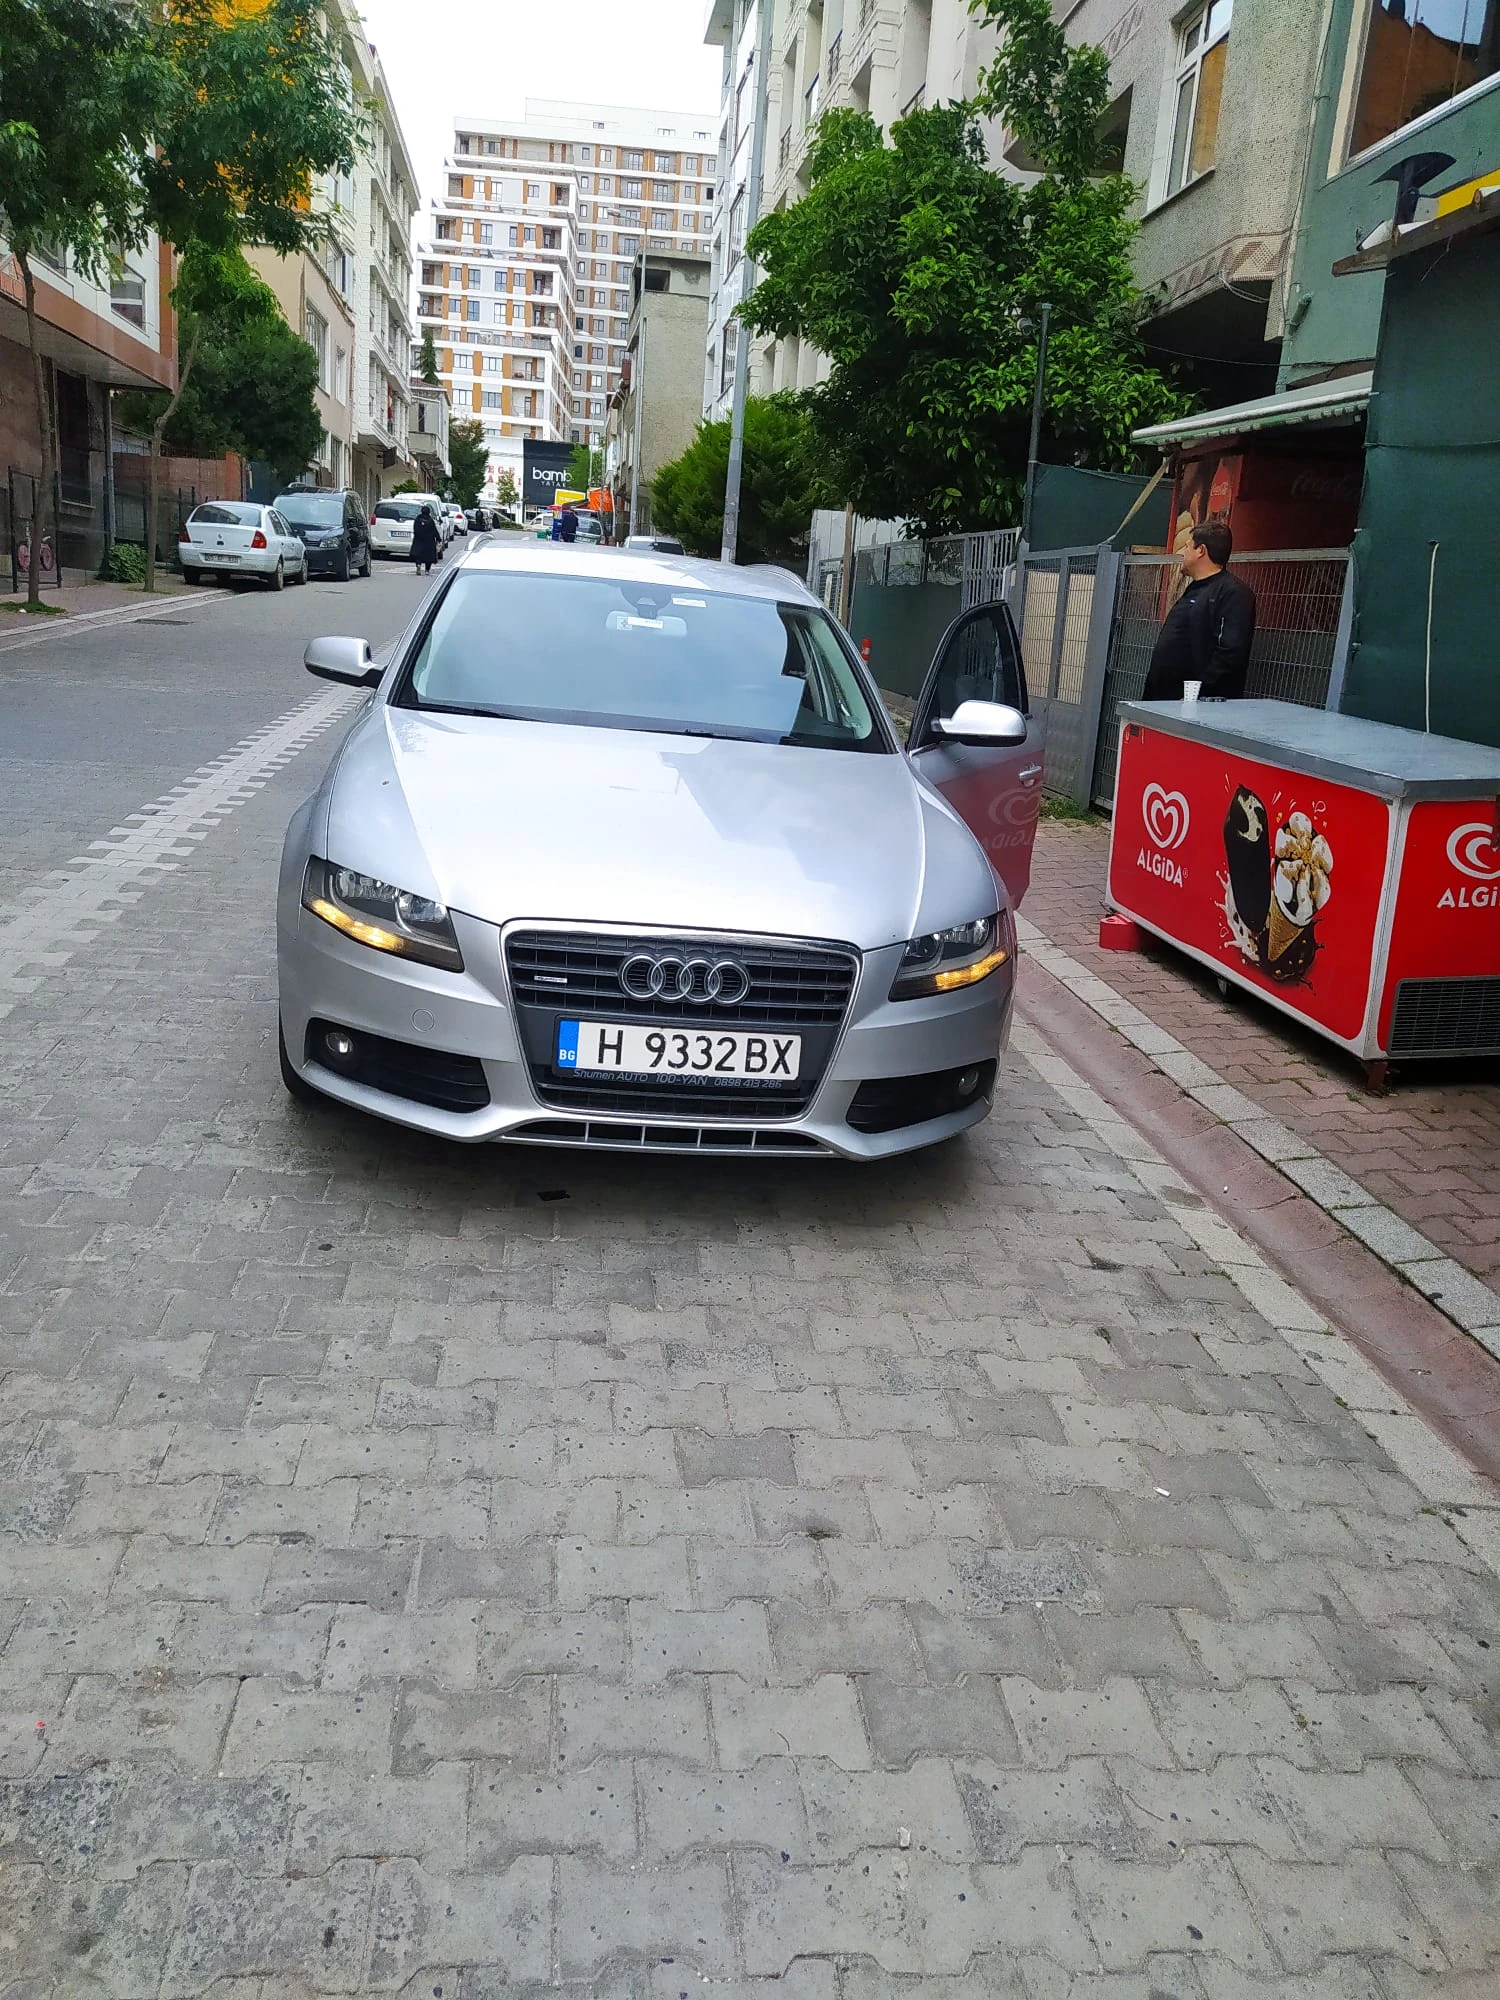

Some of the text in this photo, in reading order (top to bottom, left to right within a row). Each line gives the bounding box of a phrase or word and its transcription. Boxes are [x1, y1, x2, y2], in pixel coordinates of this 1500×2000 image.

[533, 467, 575, 481] bamb
[1436, 886, 1500, 909] ALGi
[559, 1050, 576, 1060] BG
[597, 1028, 624, 1065] H
[573, 1068, 615, 1080] Shumen
[616, 1071, 648, 1082] AUTO
[655, 1073, 708, 1085] 100-YAN
